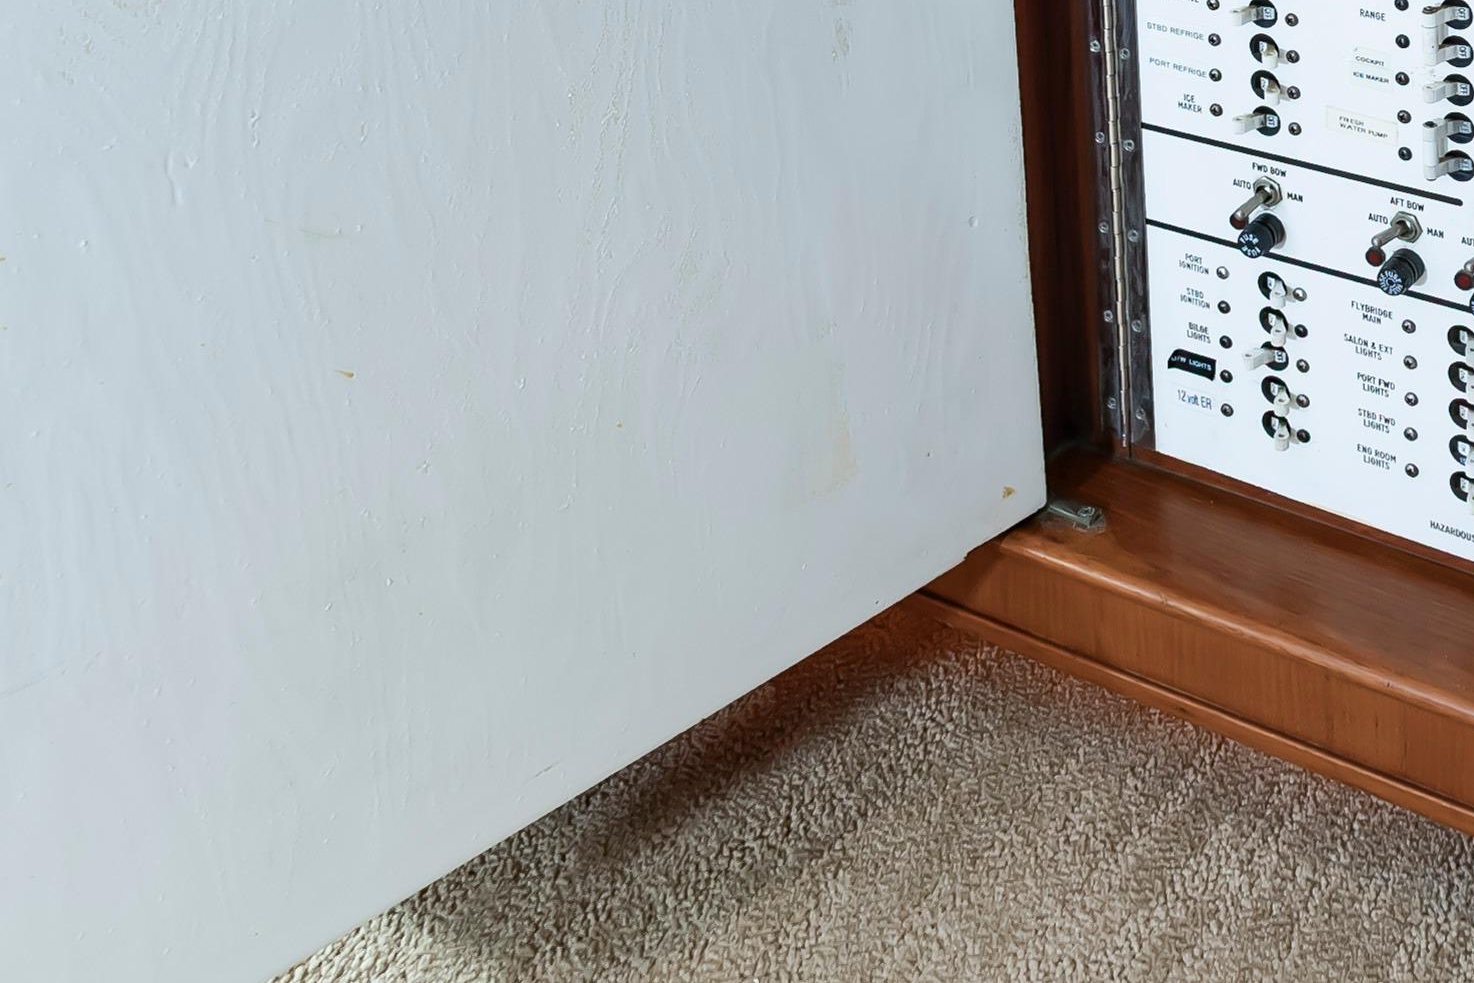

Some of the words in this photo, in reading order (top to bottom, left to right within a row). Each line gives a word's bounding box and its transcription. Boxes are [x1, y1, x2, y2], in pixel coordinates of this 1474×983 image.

[1360, 9, 1386, 21] RANGE
[1178, 102, 1202, 113] MAKER
[1252, 162, 1268, 173] FWD
[1271, 167, 1286, 177] BOW
[1233, 179, 1251, 189] AUTO
[1390, 197, 1404, 207] AFT
[1407, 200, 1424, 211] BOW
[1368, 213, 1388, 224] AUTO
[1427, 227, 1444, 238] MAN
[1185, 253, 1202, 264] PORT
[1179, 260, 1209, 275] IGNITION
[1180, 295, 1210, 309] IGNITION
[1351, 301, 1392, 319] FLYBRIDGE
[1363, 313, 1381, 324] MAIN
[1187, 330, 1211, 344] LIGHTS
[1355, 346, 1382, 360] LIGHTS
[1357, 372, 1375, 384] PORT
[1378, 378, 1395, 390] FWD
[1363, 384, 1389, 398] LIGHTS
[1358, 408, 1377, 420] STBD
[1379, 415, 1395, 426] FWD
[1363, 420, 1390, 434] LIGHTS
[1357, 444, 1372, 455] ENG
[1375, 450, 1396, 463] ROOM
[1363, 456, 1390, 470] LIGHTS
